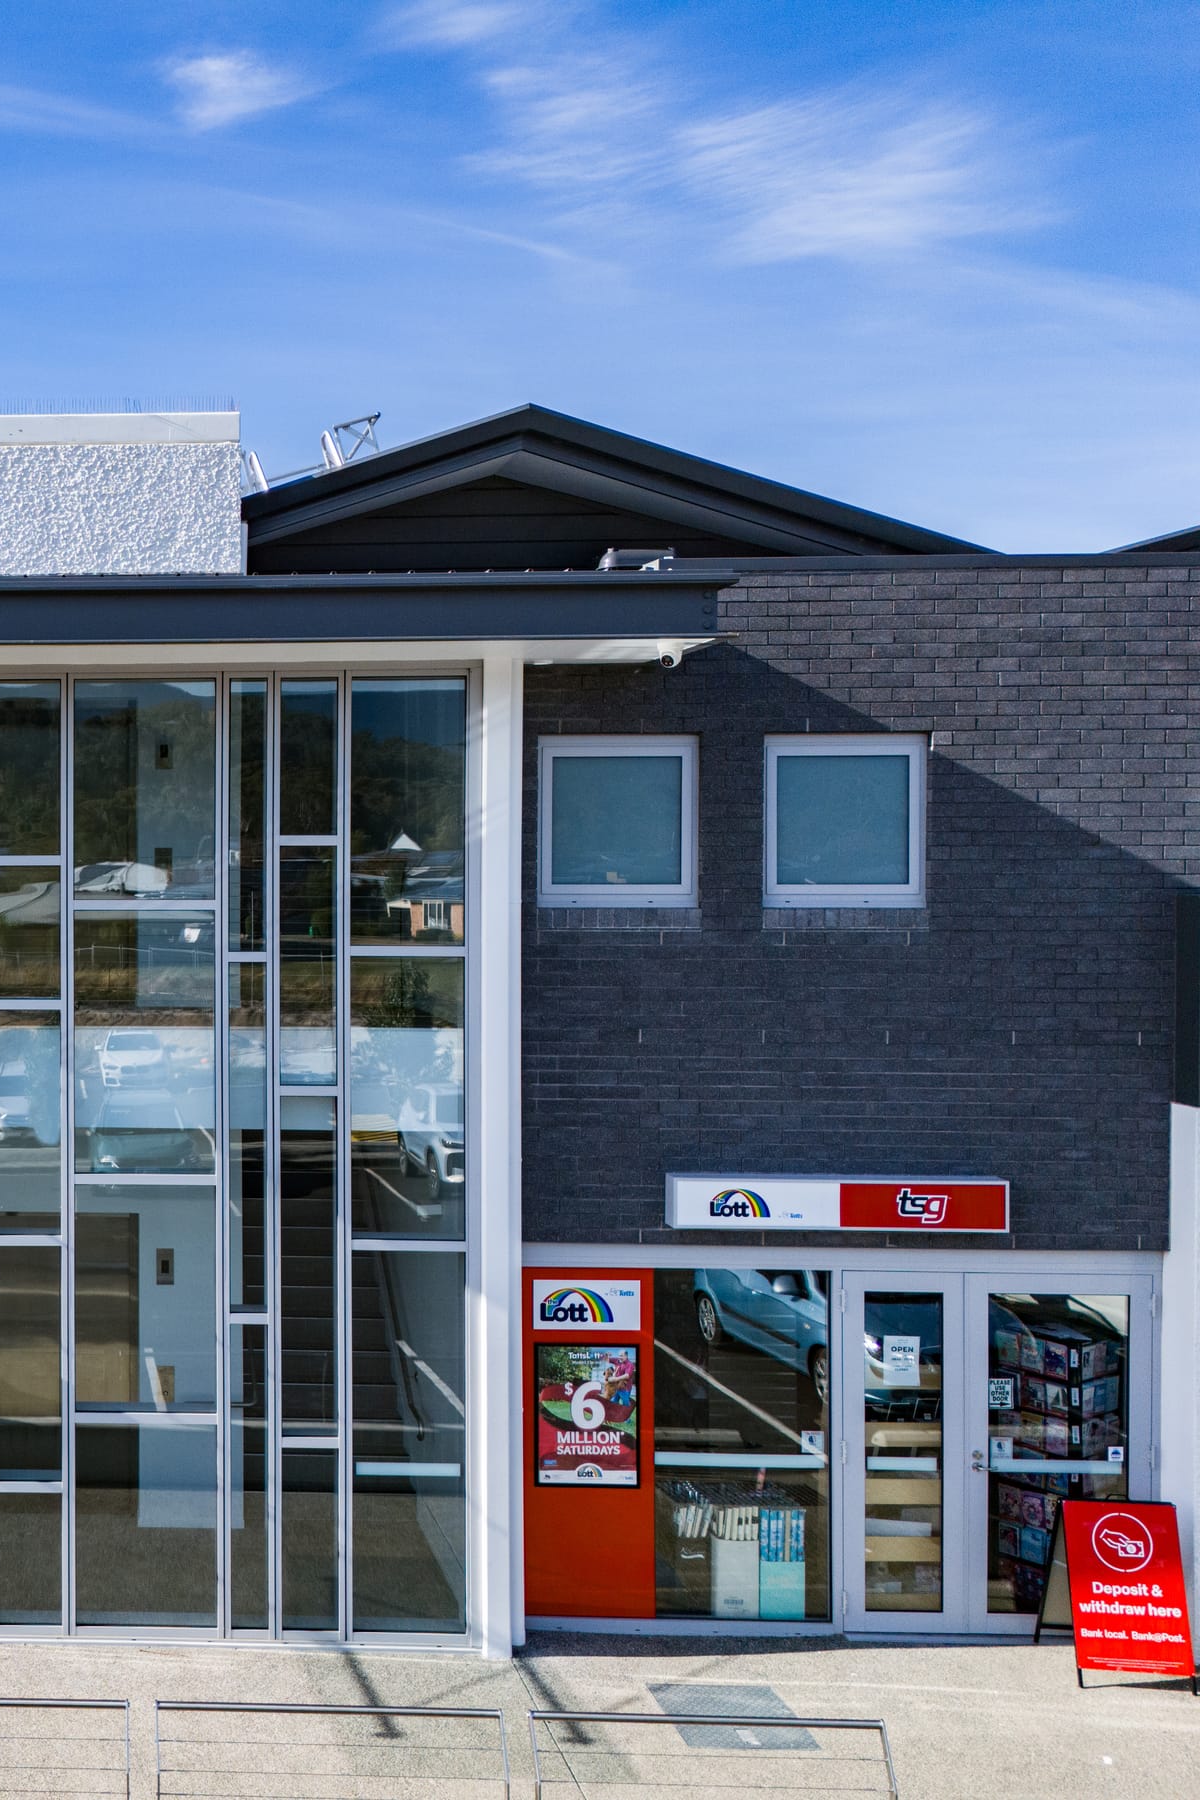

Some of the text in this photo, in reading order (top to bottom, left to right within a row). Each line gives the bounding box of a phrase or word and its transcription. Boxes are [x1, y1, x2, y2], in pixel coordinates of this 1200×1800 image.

[709, 1201, 750, 1218] Lott
[896, 1188, 948, 1224] tsg
[540, 1303, 588, 1322] Lott
[557, 1445, 621, 1456] SATURDAYS
[1092, 1581, 1163, 1597] Deposit &
[1079, 1600, 1183, 1618] withdraw here
[1080, 1628, 1186, 1643] Bank local. Bank@Post.
